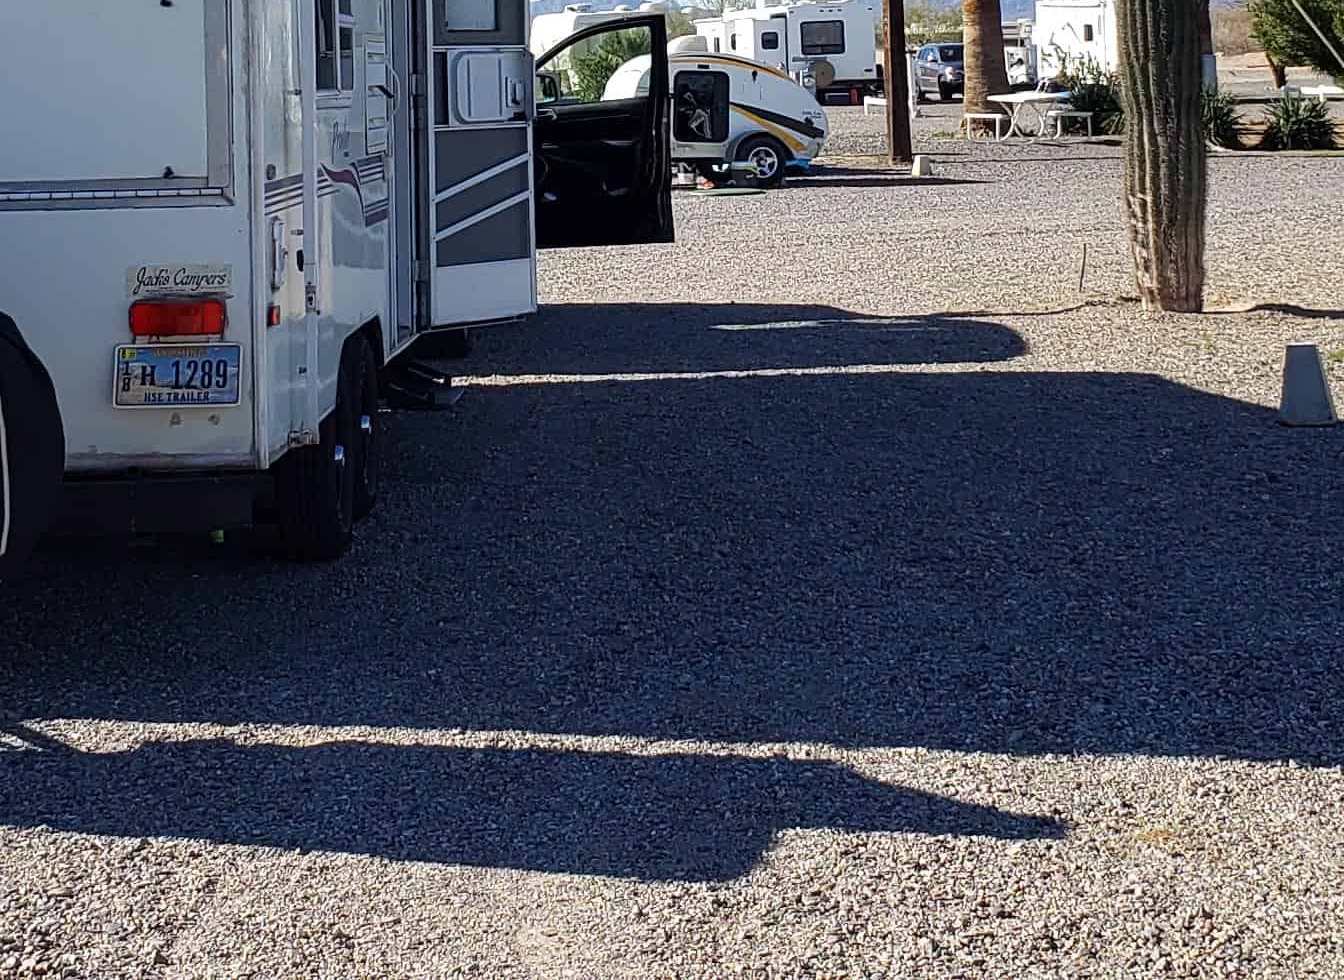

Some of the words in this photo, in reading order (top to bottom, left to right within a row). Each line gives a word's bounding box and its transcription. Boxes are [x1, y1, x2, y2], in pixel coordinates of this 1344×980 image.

[173, 267, 227, 292] Campers
[140, 365, 157, 386] H
[171, 360, 228, 389] 1289
[166, 391, 210, 402] TRAILER
